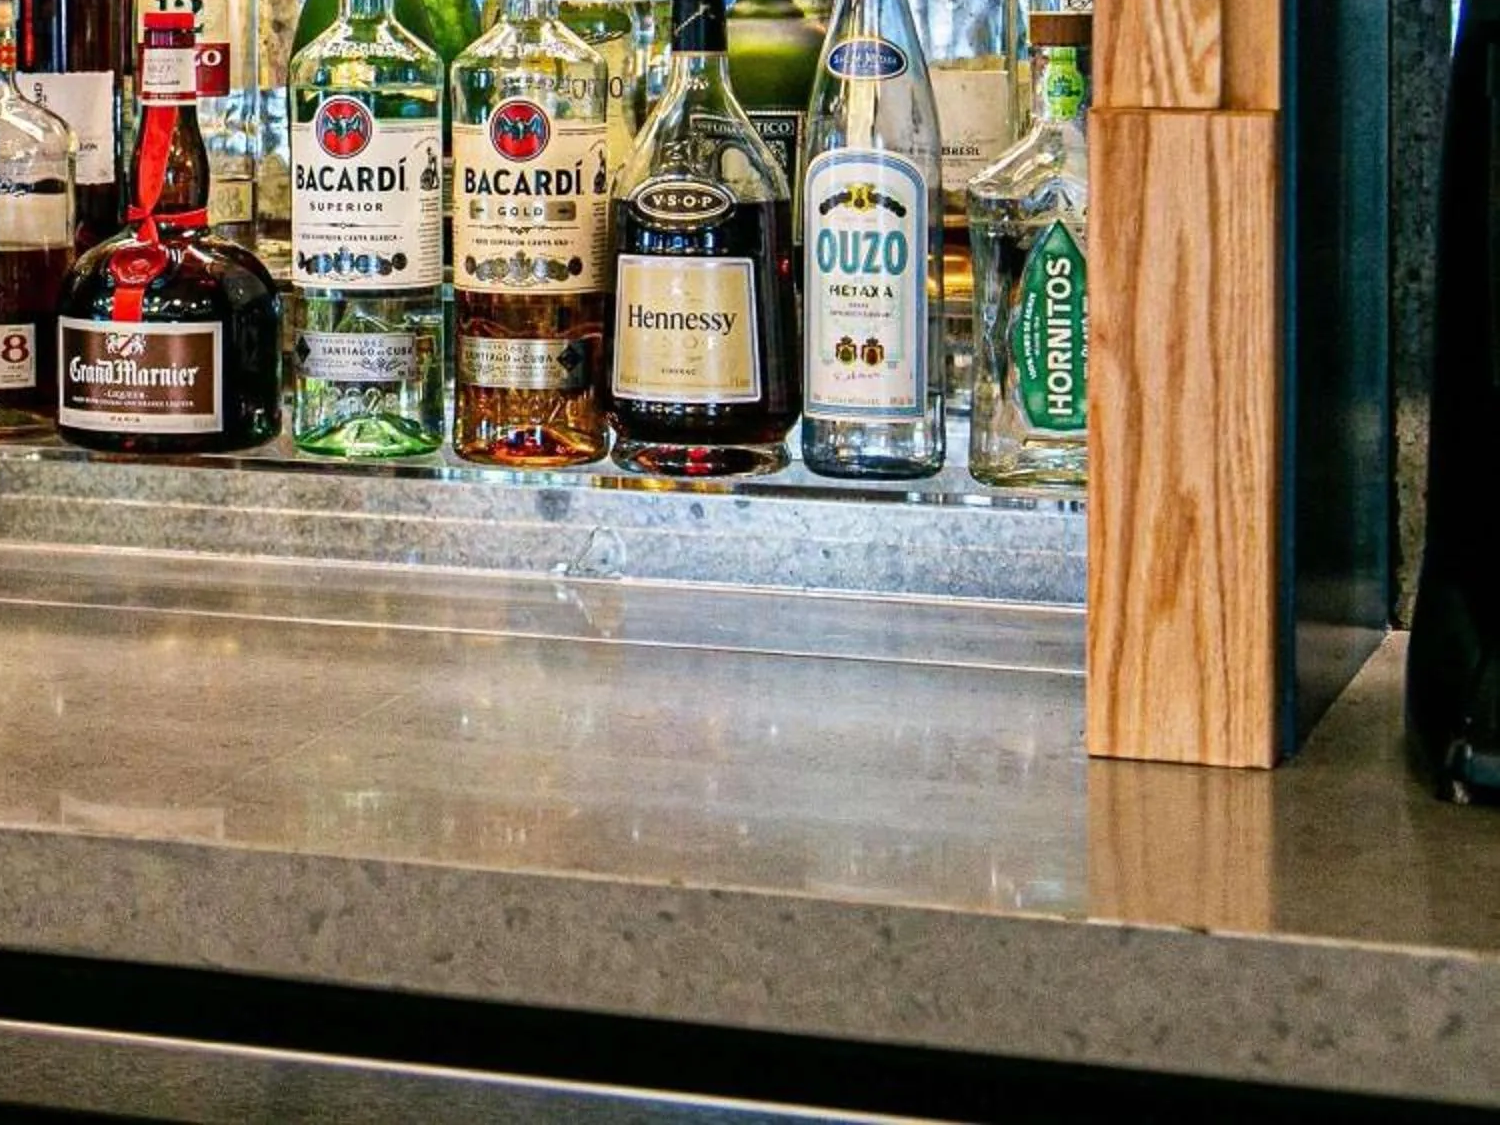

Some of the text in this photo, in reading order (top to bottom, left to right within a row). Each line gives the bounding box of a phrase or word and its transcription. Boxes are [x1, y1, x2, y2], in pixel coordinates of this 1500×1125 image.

[296, 157, 406, 192] BACARDÍ
[464, 159, 584, 196] BACARDÍ
[309, 201, 384, 212] SUPERIOR
[497, 205, 544, 216] GOLD
[816, 228, 909, 276] OUZO
[829, 284, 893, 298] METAXA
[627, 303, 739, 335] Hennessy
[1, 333, 30, 364] 8
[321, 346, 375, 356] SANTIAGO
[1046, 257, 1073, 416] HORNITOS
[69, 356, 200, 387] Grand Marnier
